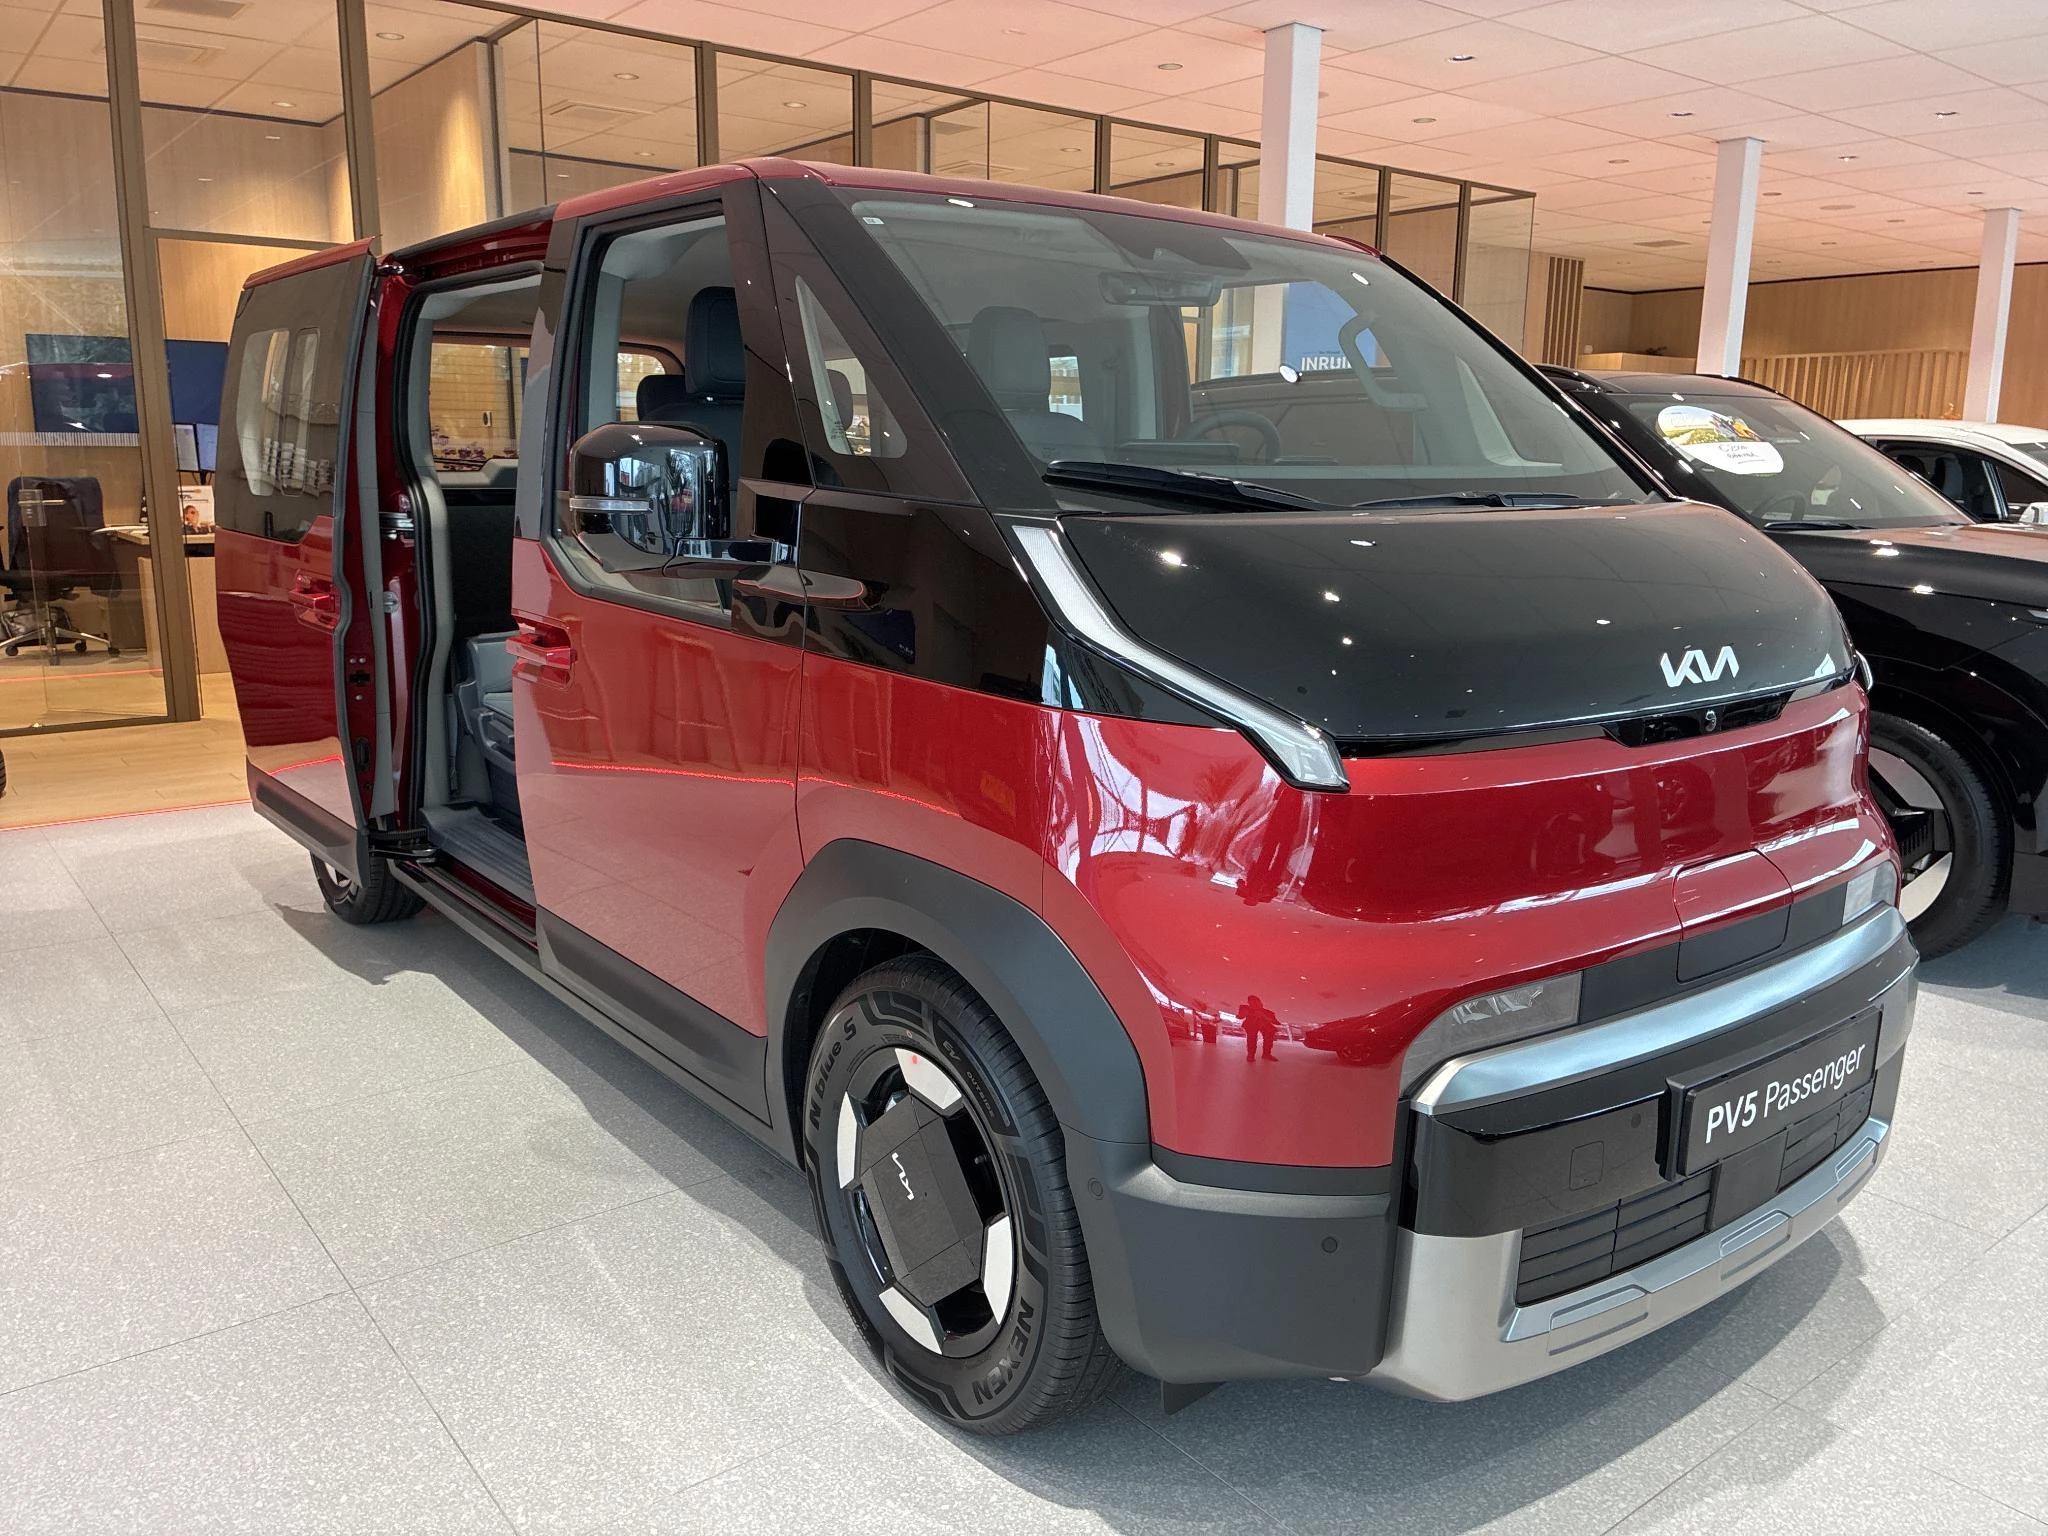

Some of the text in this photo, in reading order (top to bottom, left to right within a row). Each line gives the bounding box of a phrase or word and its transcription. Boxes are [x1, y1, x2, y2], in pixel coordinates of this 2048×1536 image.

[1660, 645, 1740, 688] KIA
[809, 1015, 857, 1131] N blue S
[1705, 1044, 1866, 1144] PV5 Passenger
[891, 1152, 915, 1201] KIA
[971, 1295, 1035, 1406] NEXEN
